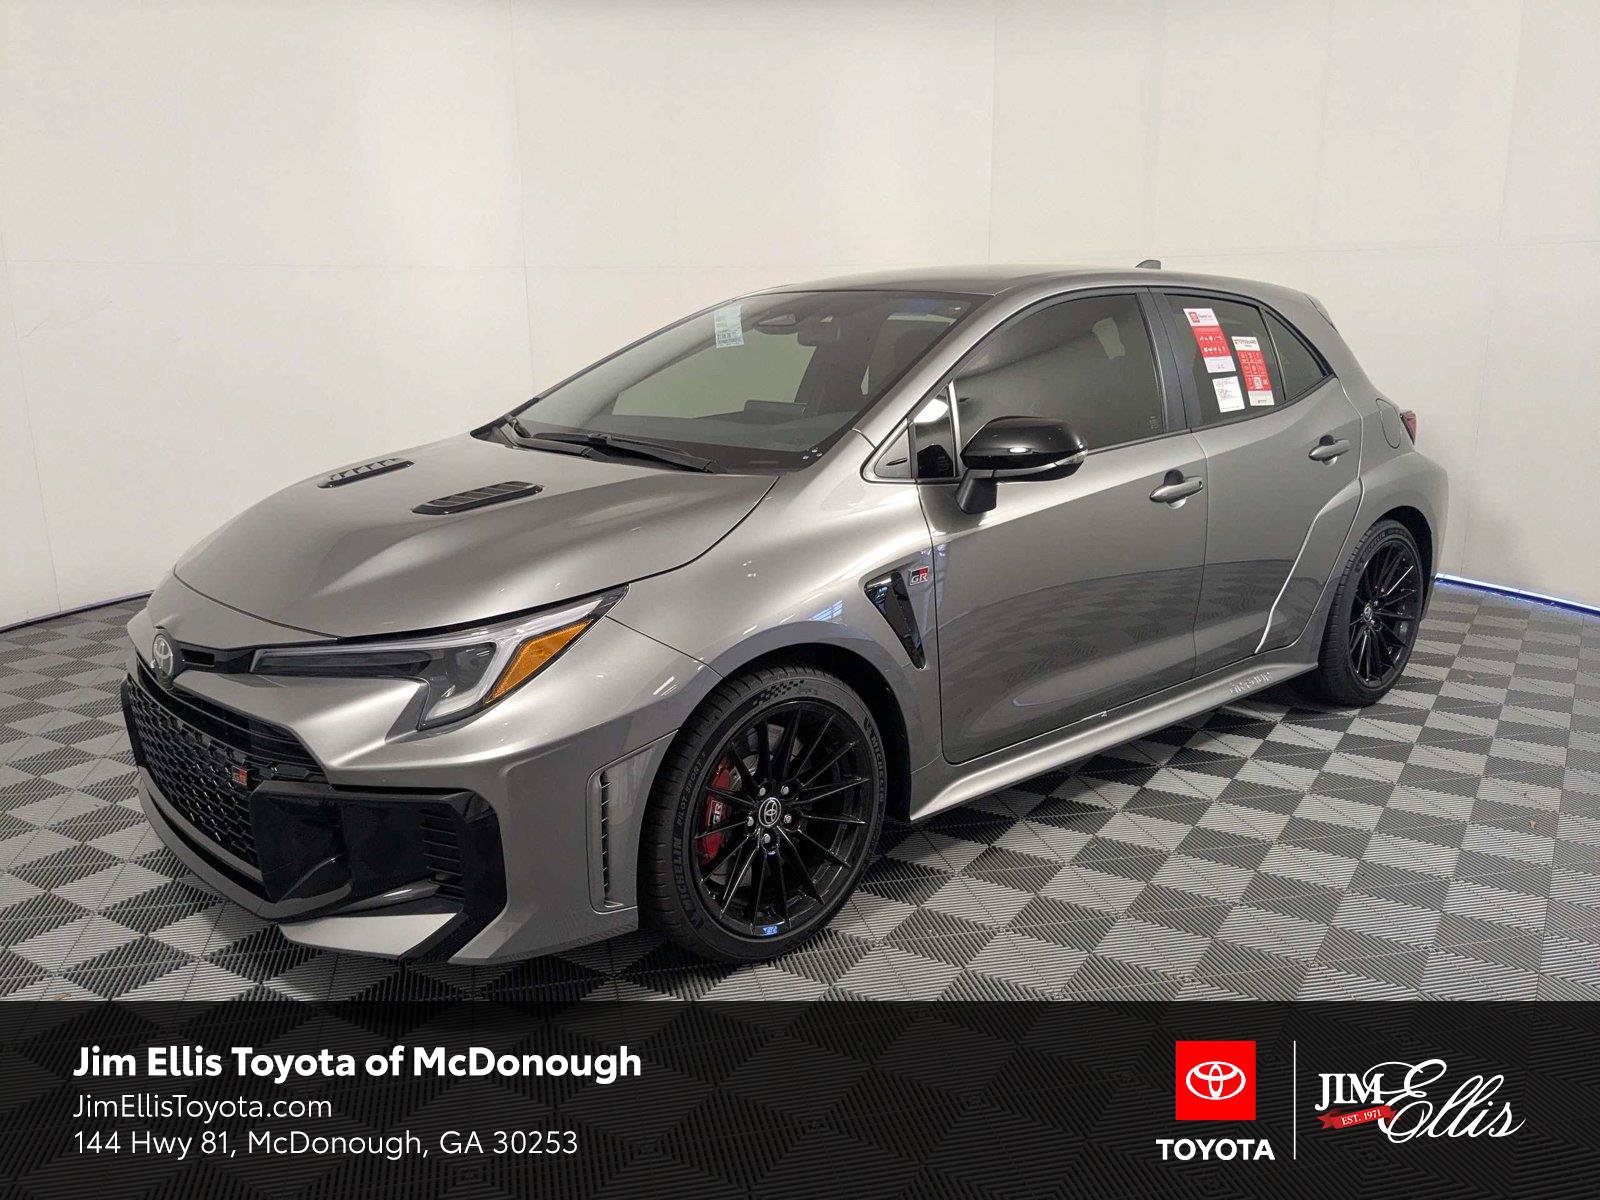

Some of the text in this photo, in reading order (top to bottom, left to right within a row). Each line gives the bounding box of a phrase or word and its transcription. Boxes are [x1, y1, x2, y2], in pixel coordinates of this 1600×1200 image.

[912, 571, 928, 583] GR
[685, 760, 703, 794] SPORT
[676, 795, 689, 825] PILOT
[672, 836, 695, 911] MICHELIN
